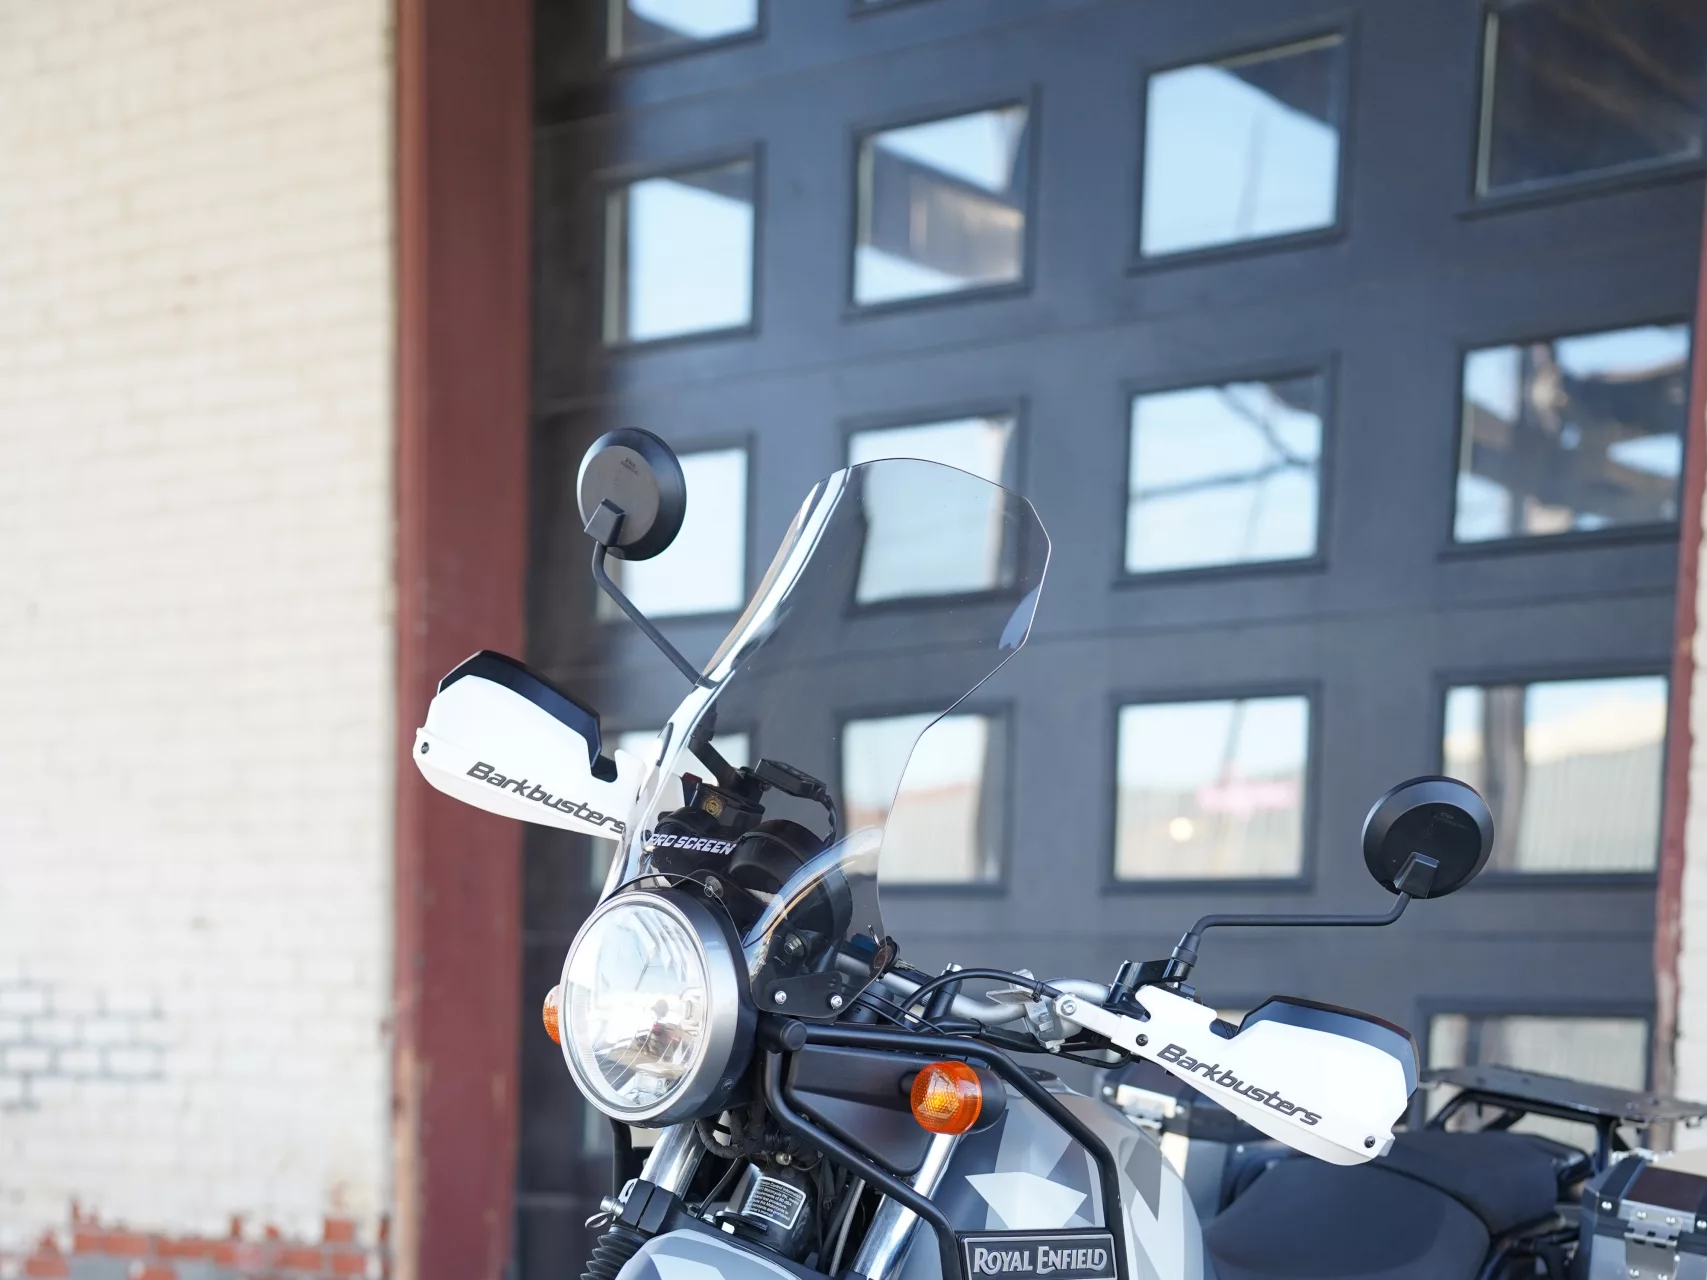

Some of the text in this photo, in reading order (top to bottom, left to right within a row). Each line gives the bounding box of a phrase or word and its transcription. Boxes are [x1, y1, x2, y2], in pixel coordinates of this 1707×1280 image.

[466, 761, 628, 834] Barkbusters
[647, 833, 737, 855] PRO SCREEN
[1156, 1043, 1322, 1126] Barkbusters
[973, 1245, 1107, 1275] ROYAL ENFIELD
